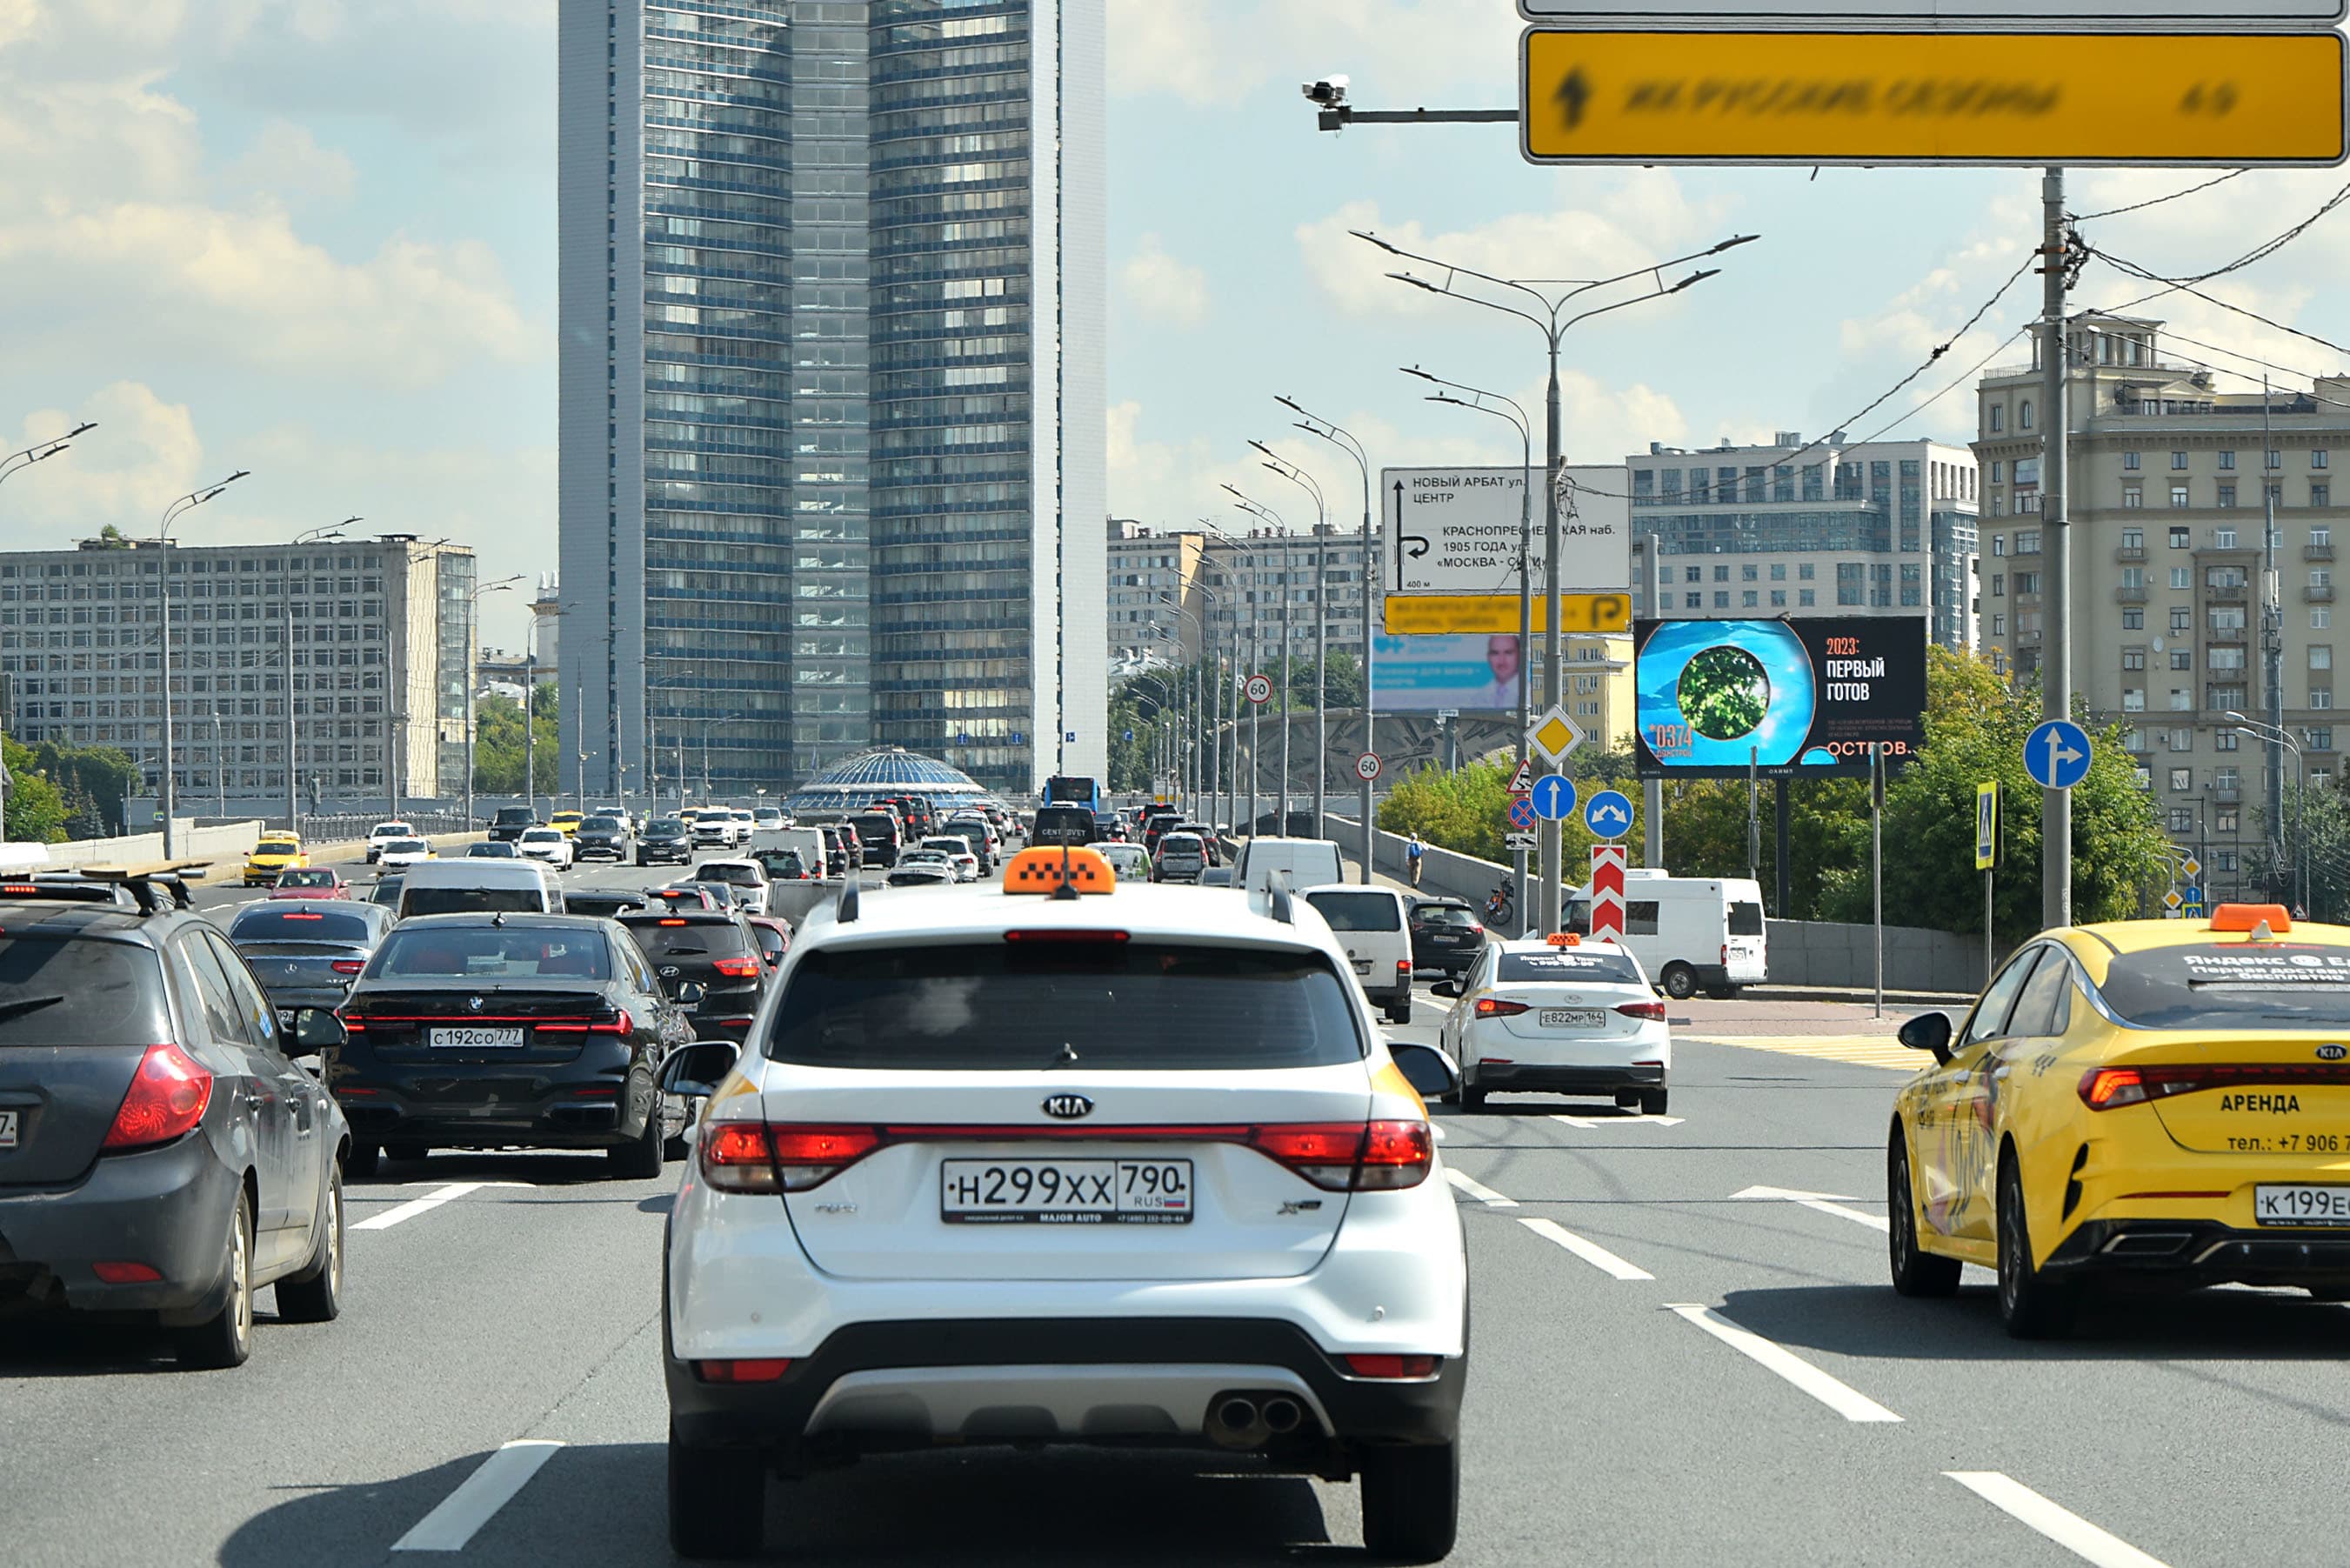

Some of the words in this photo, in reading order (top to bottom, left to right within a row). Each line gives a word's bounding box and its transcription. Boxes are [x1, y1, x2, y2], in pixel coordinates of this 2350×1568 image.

[1413, 475, 1460, 487] НОВЫЙ
[1464, 477, 1505, 487] АРБАТ
[1413, 493, 1454, 504] ЦЕНТР
[1443, 525, 1586, 537] КРАСНОПРЕЕКАЯ
[1590, 524, 1615, 535] наб.
[1444, 542, 1470, 551] 1905
[1474, 542, 1507, 552] ГОДА
[1437, 557, 1497, 567] «МОСКВА
[1826, 637, 1859, 655] 2023:
[1826, 657, 1885, 678] ПЕРВЫЙ
[1251, 684, 1265, 695] 60
[1826, 683, 1870, 701] ГОТОВ
[1361, 761, 1376, 772] 60
[2184, 956, 2287, 965] Яндекс
[497, 1029, 519, 1041] 777
[2320, 1048, 2344, 1058] KIA
[1049, 1098, 1086, 1114] KIA
[2220, 1094, 2300, 1114] АРЕНДА
[2227, 1137, 2272, 1151] тел.:
[2279, 1134, 2300, 1151] +7
[2307, 1134, 2339, 1151] 906
[958, 1166, 1112, 1204] Н299ХХ
[1121, 1165, 1179, 1194] 790
[1134, 1197, 1163, 1207] RUS
[2266, 1190, 2350, 1216] К199Е
[1040, 1213, 1073, 1223] MAJOR
[1076, 1213, 1102, 1223] AUTO
